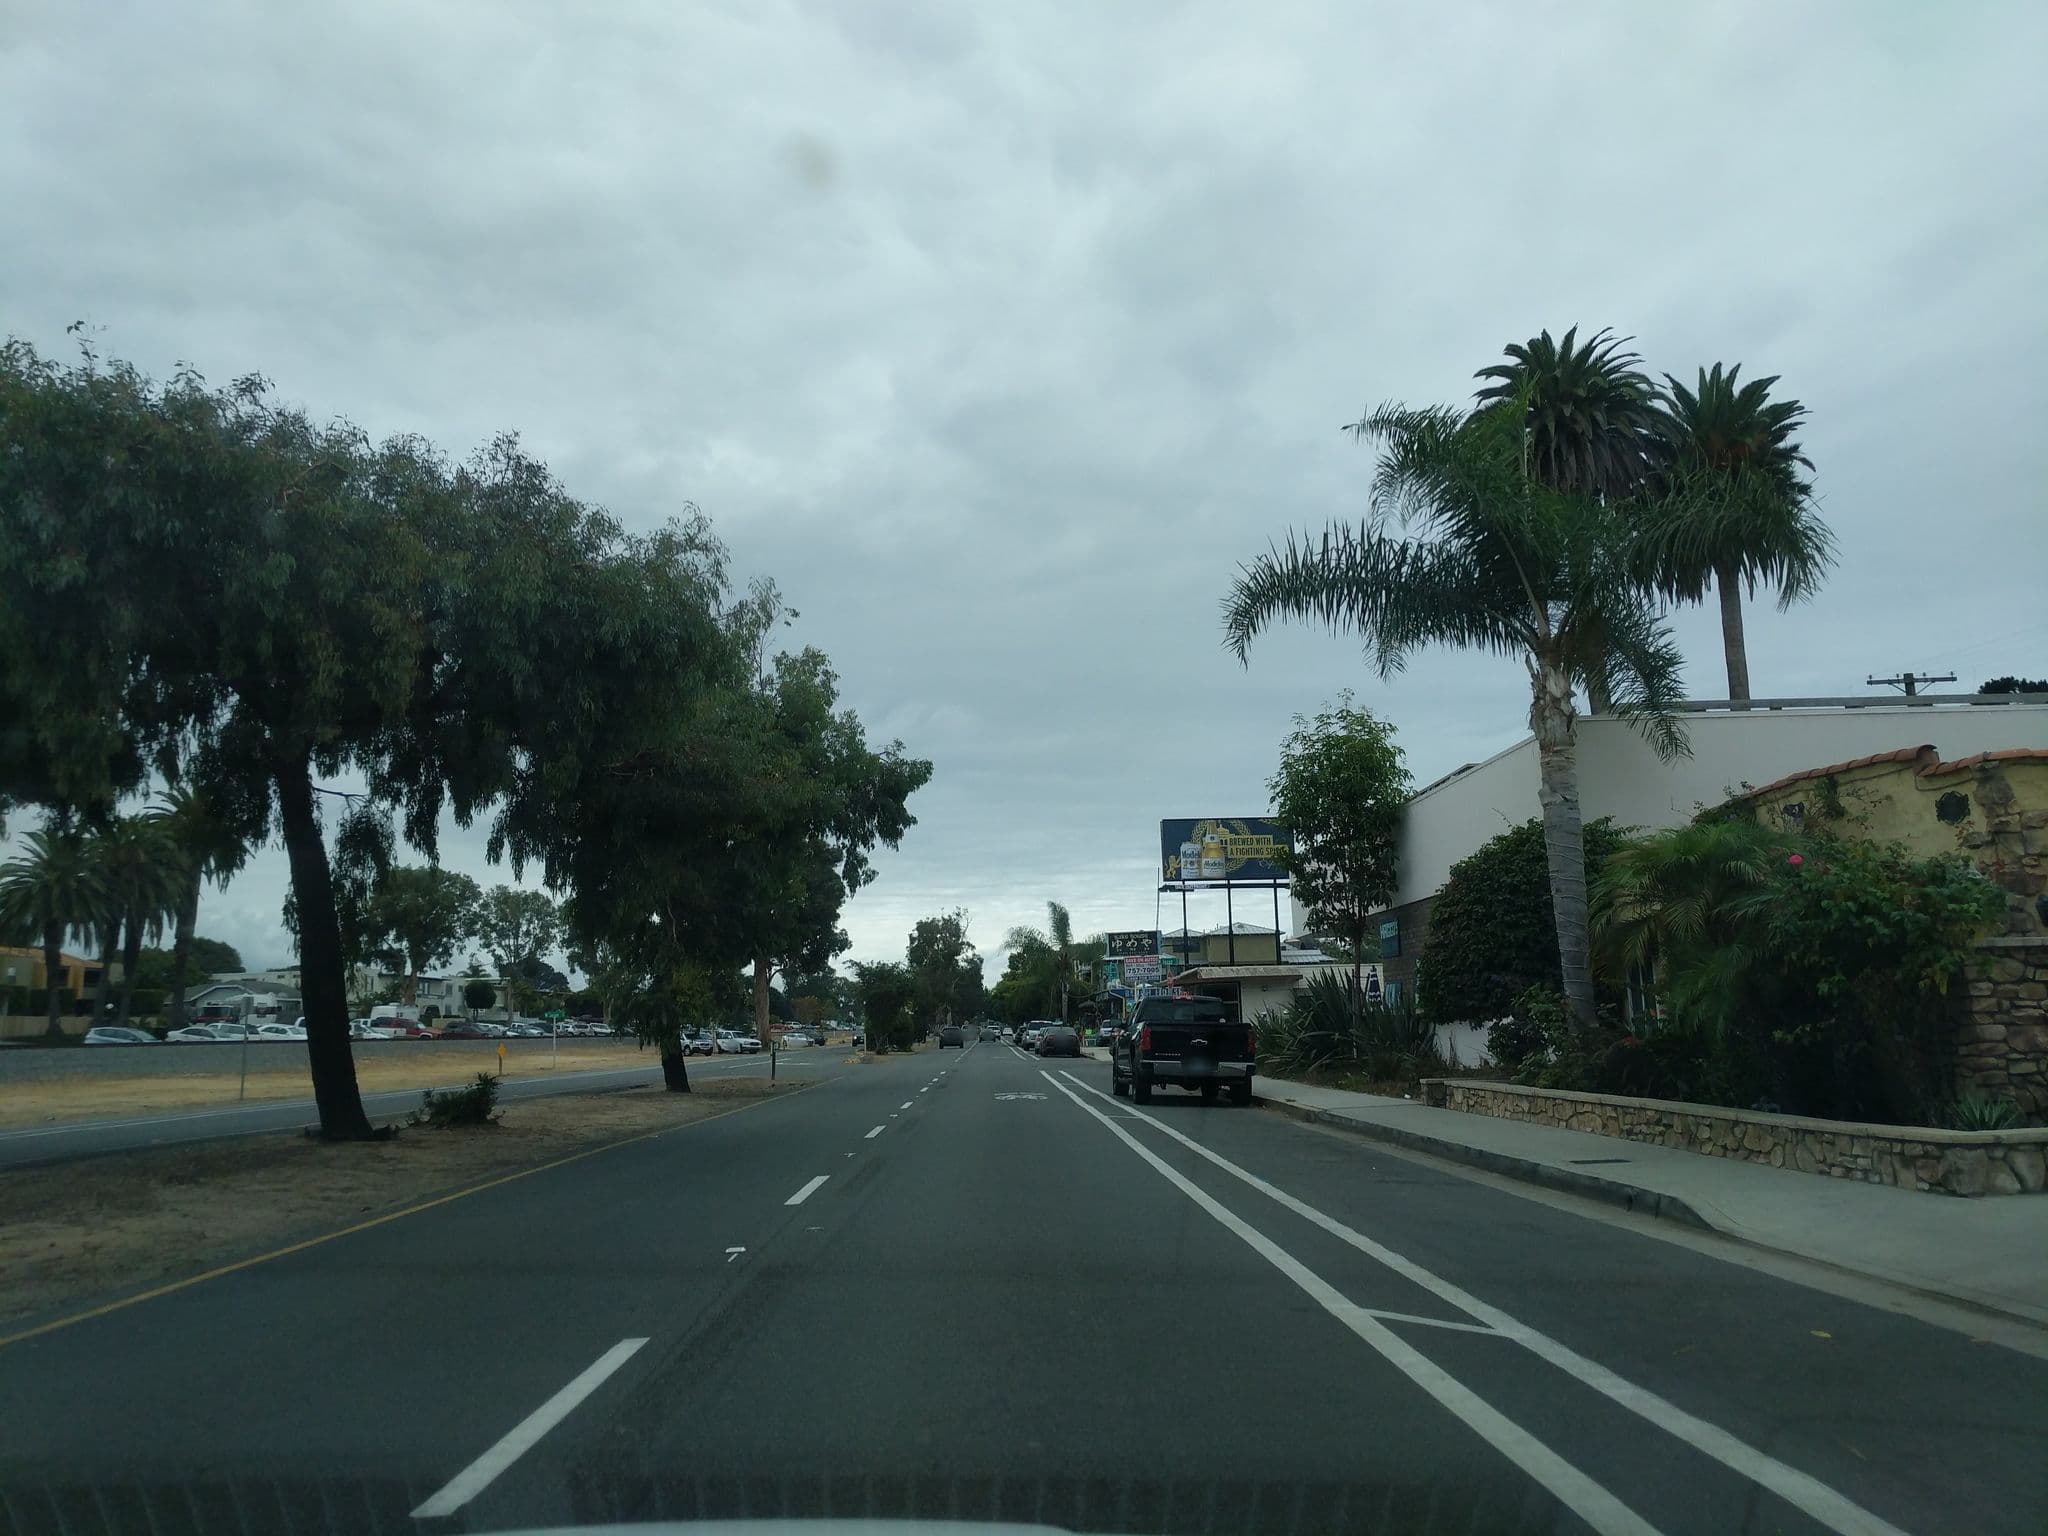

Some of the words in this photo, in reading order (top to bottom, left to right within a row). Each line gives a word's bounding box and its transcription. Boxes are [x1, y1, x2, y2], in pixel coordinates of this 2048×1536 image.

[1229, 837, 1254, 846] BREWED
[1254, 837, 1271, 845] WITH
[1236, 847, 1264, 855] FIGHTING
